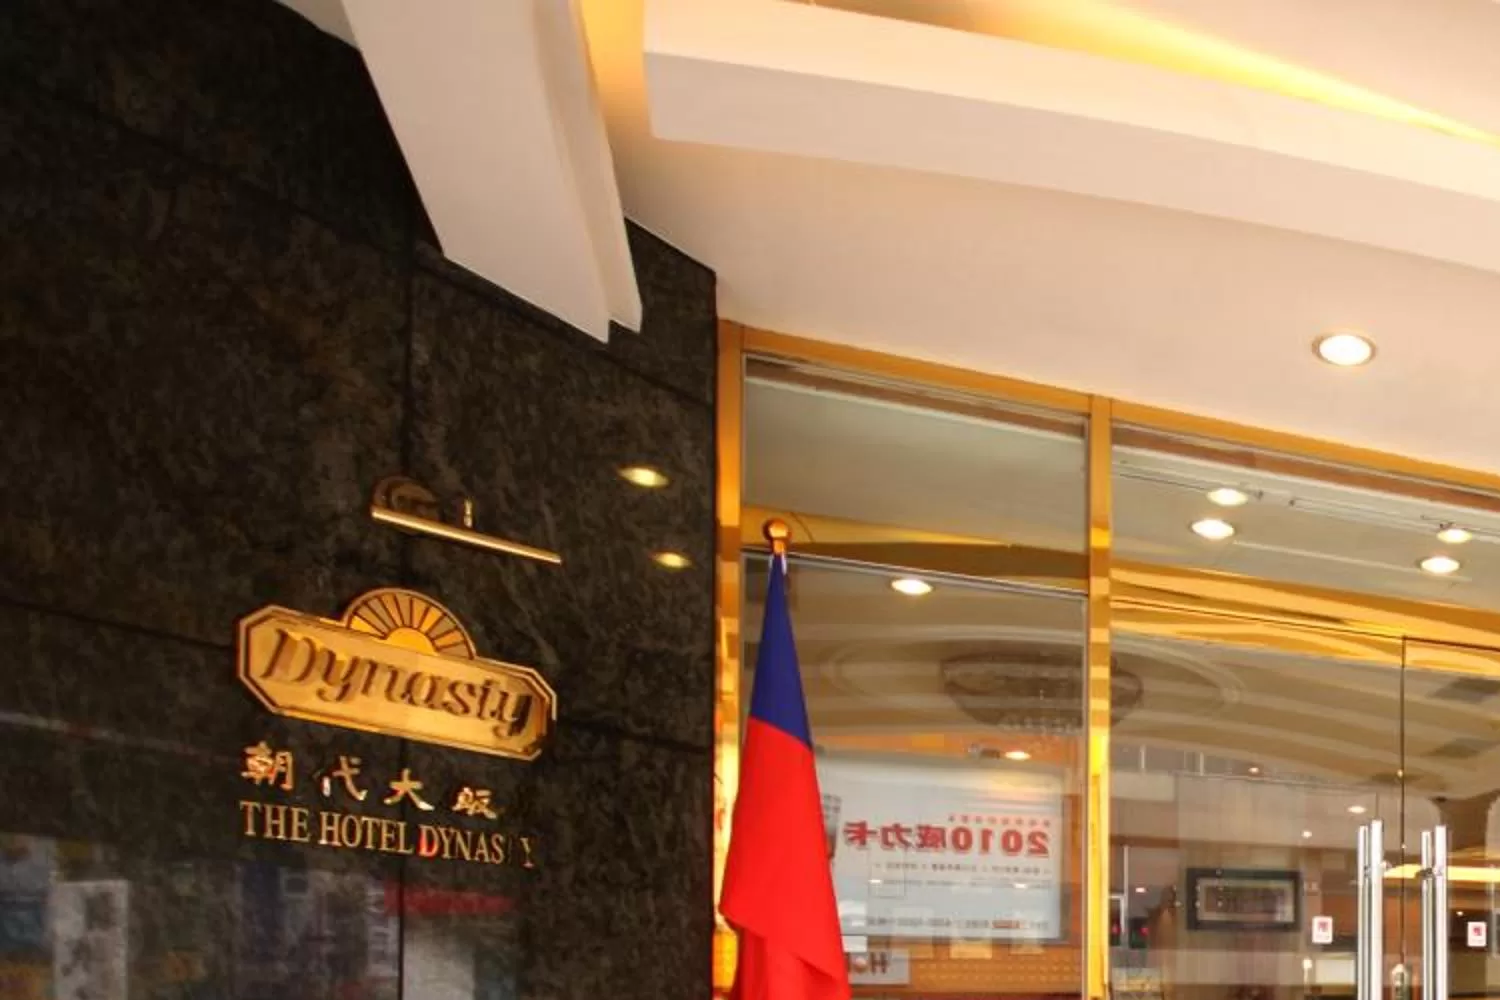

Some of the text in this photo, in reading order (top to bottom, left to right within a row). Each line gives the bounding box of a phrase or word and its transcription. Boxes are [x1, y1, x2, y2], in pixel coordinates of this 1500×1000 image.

[260, 628, 533, 737] Dynasty
[240, 801, 534, 868] THE HOTEL DYNASY
